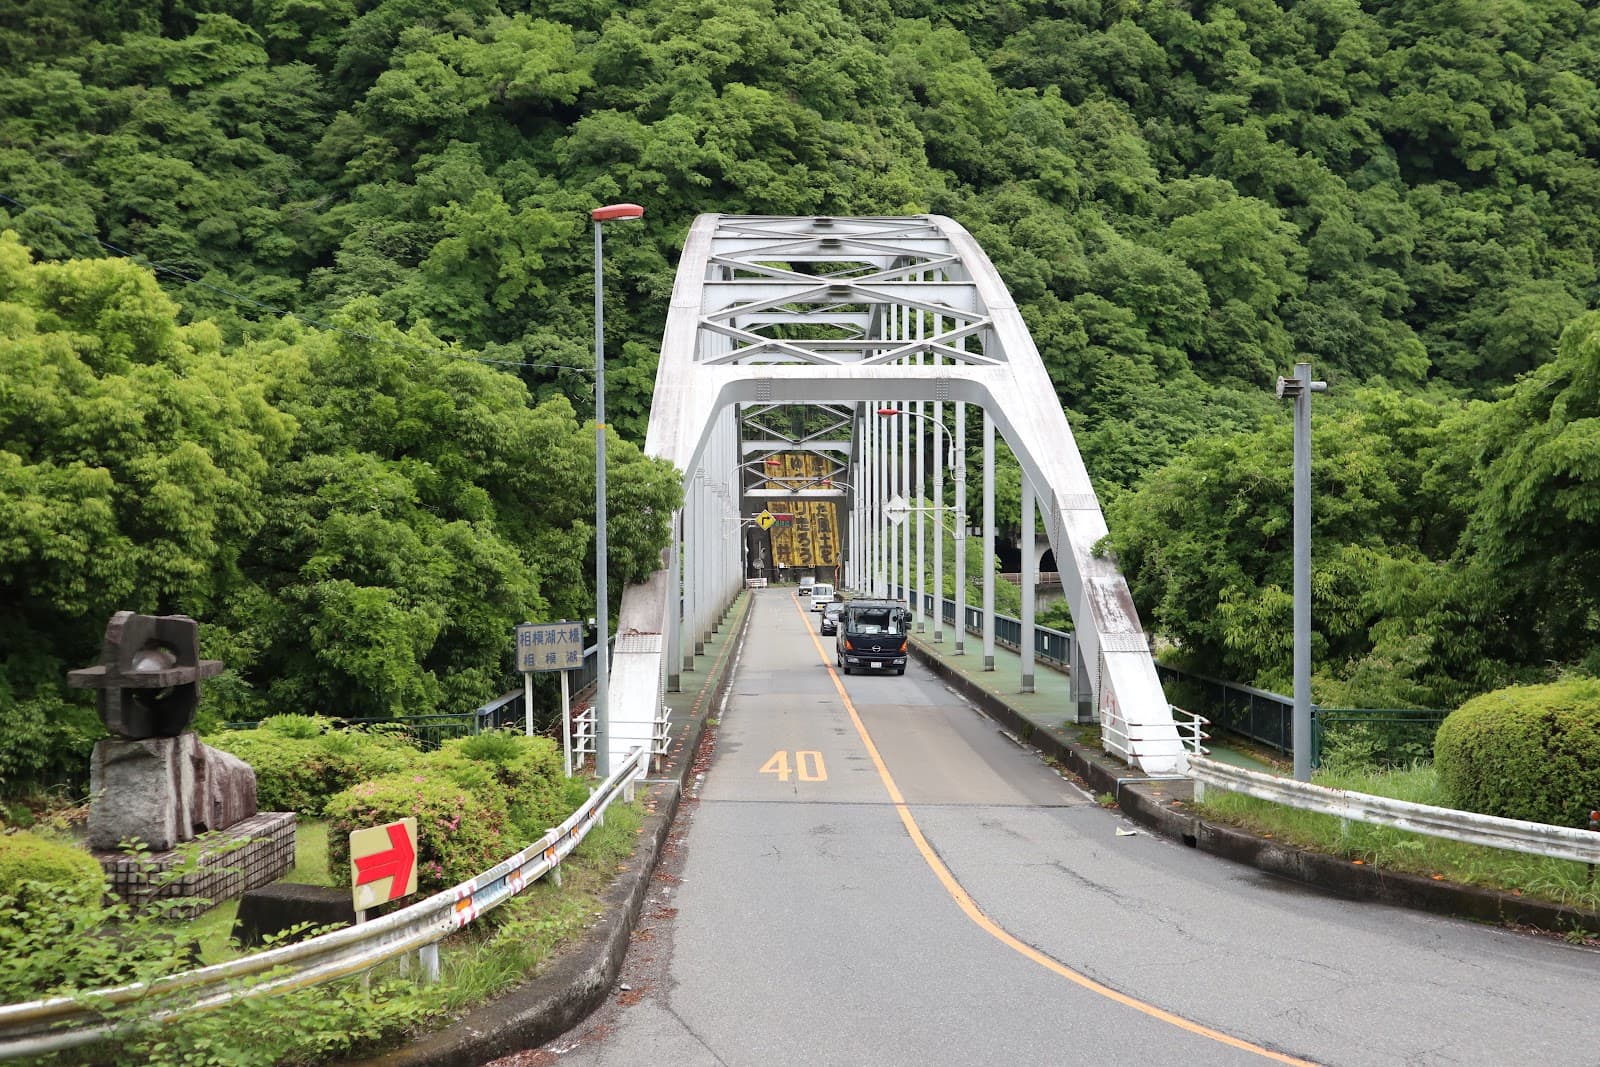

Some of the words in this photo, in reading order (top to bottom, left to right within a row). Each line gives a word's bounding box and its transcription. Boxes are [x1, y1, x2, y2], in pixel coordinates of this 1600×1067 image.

[520, 628, 580, 647] 相模湖大橋
[523, 650, 578, 667] 相模湖
[759, 750, 828, 781] 40
